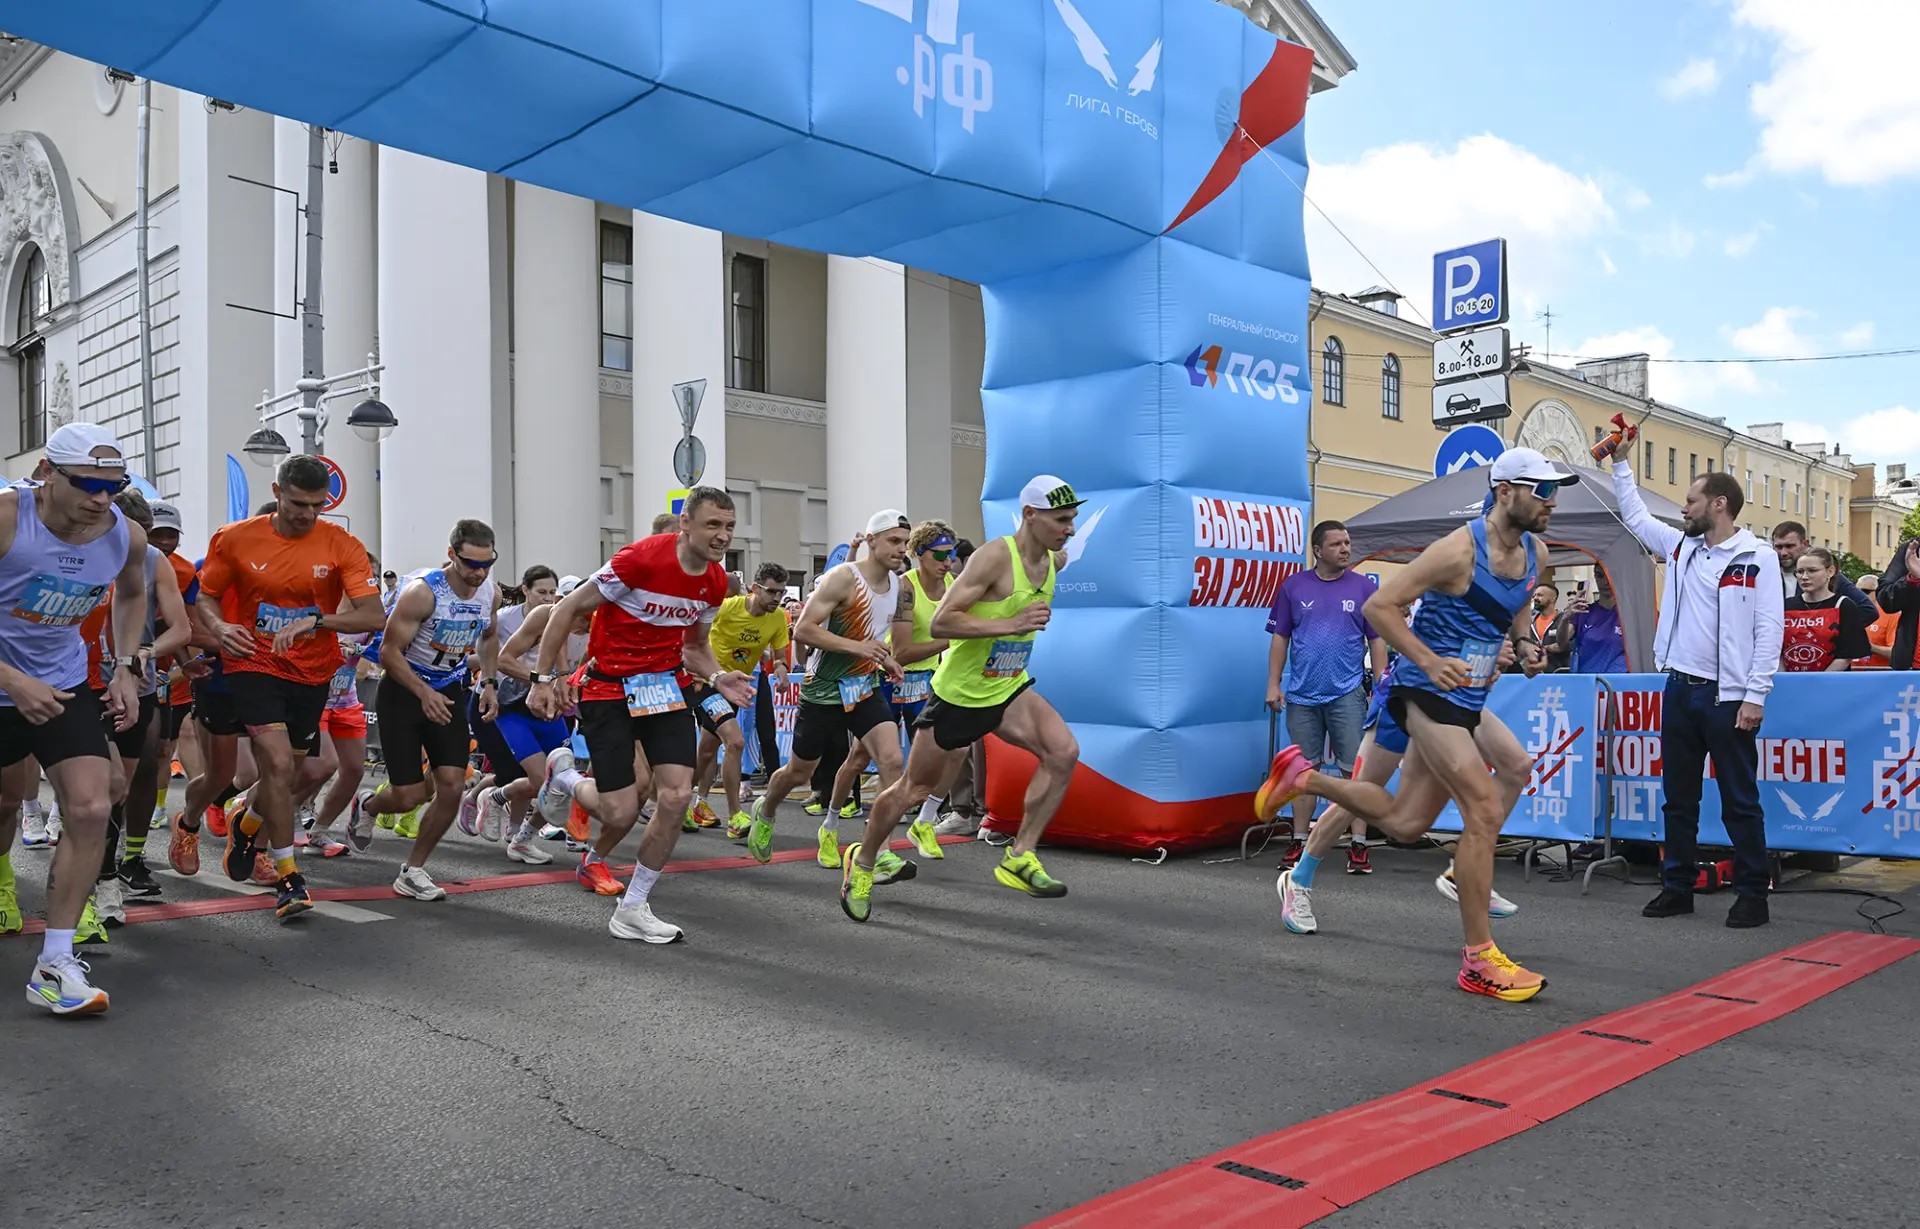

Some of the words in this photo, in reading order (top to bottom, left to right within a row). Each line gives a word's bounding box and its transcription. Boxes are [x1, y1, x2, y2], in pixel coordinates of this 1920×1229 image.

[896, 32, 994, 134] .рф
[1065, 93, 1111, 116] ЛИГА
[1116, 106, 1159, 140] ГЕРОЕВ
[1444, 255, 1481, 321] P
[1456, 304, 1465, 313] 10
[1466, 300, 1478, 311] 15
[1480, 298, 1494, 310] 20
[1208, 313, 1263, 336] ГЕНЕРАЛЬНЫЙ
[1264, 327, 1299, 344] СПОНСОР
[1224, 352, 1300, 404] ПСБ
[1438, 354, 1498, 375] 8.00-18.00
[1192, 495, 1304, 555] ВЫБЕГАЮ
[32, 588, 98, 617] 70188
[1188, 556, 1225, 607] ЗА
[1221, 559, 1304, 608] РАМК
[1341, 599, 1356, 612] 10
[632, 683, 676, 707] 70054
[1527, 710, 1574, 754] ЗА
[1611, 780, 1662, 822] ЛЕТ
